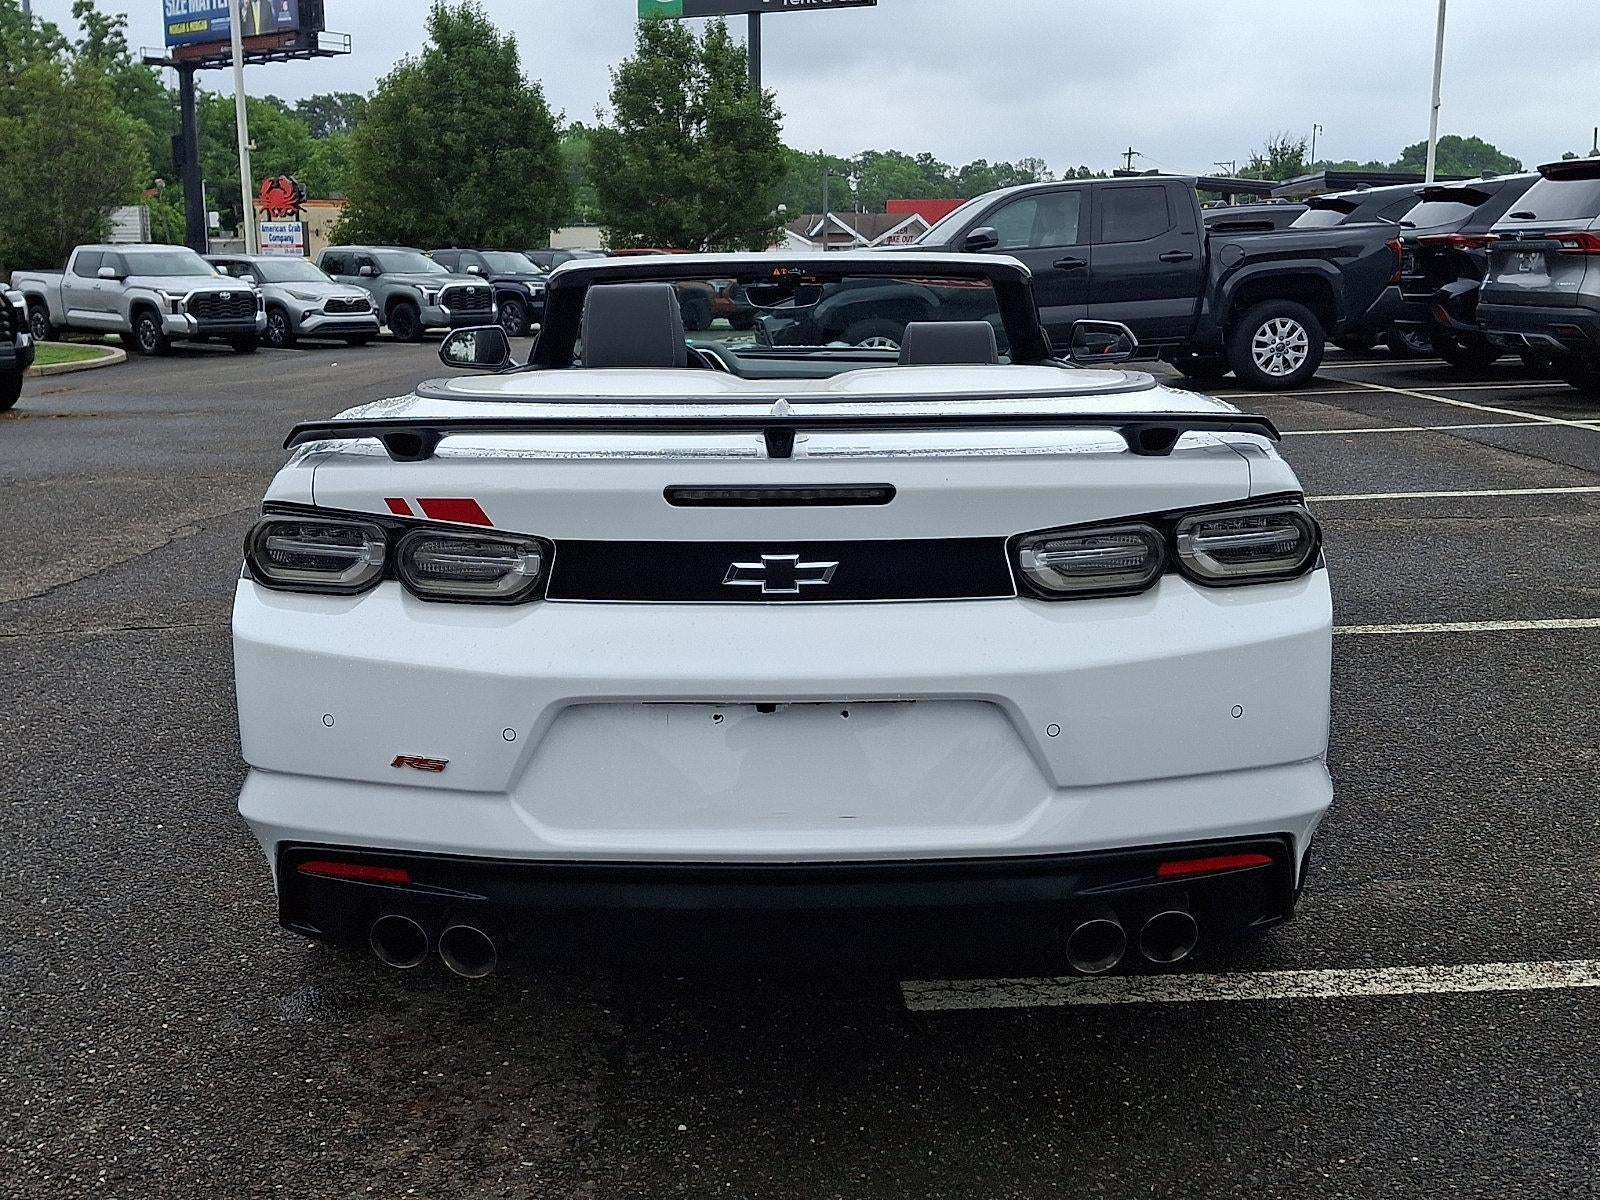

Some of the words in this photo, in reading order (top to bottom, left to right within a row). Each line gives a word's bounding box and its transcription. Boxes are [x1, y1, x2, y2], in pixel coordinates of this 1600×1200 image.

[165, 0, 187, 17] SIZE
[188, 0, 228, 13] MATTE
[262, 224, 286, 232] American
[288, 224, 301, 232] Crab
[269, 233, 294, 243] Company
[390, 754, 449, 772] RS
